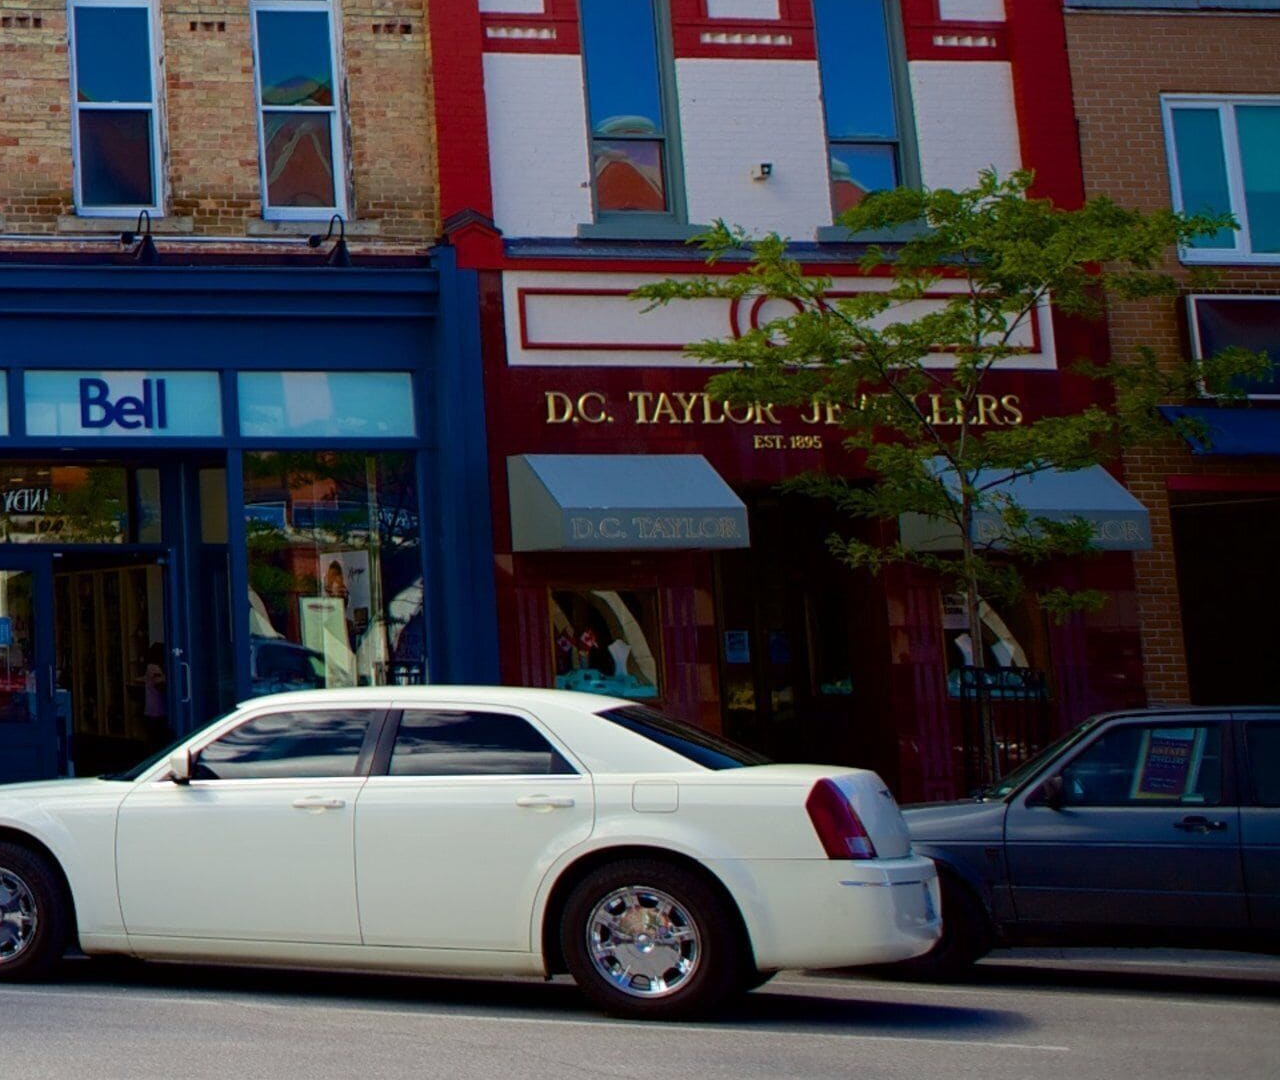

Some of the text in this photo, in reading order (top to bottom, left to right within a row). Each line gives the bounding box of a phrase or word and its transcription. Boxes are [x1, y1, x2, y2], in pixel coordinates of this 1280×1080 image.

[80, 378, 167, 429] Bell
[545, 391, 615, 425] D.C.
[628, 391, 783, 425] TAYLOR
[753, 435, 823, 449] EST. 1895
[571, 517, 741, 540] D.C. TAYLOR
